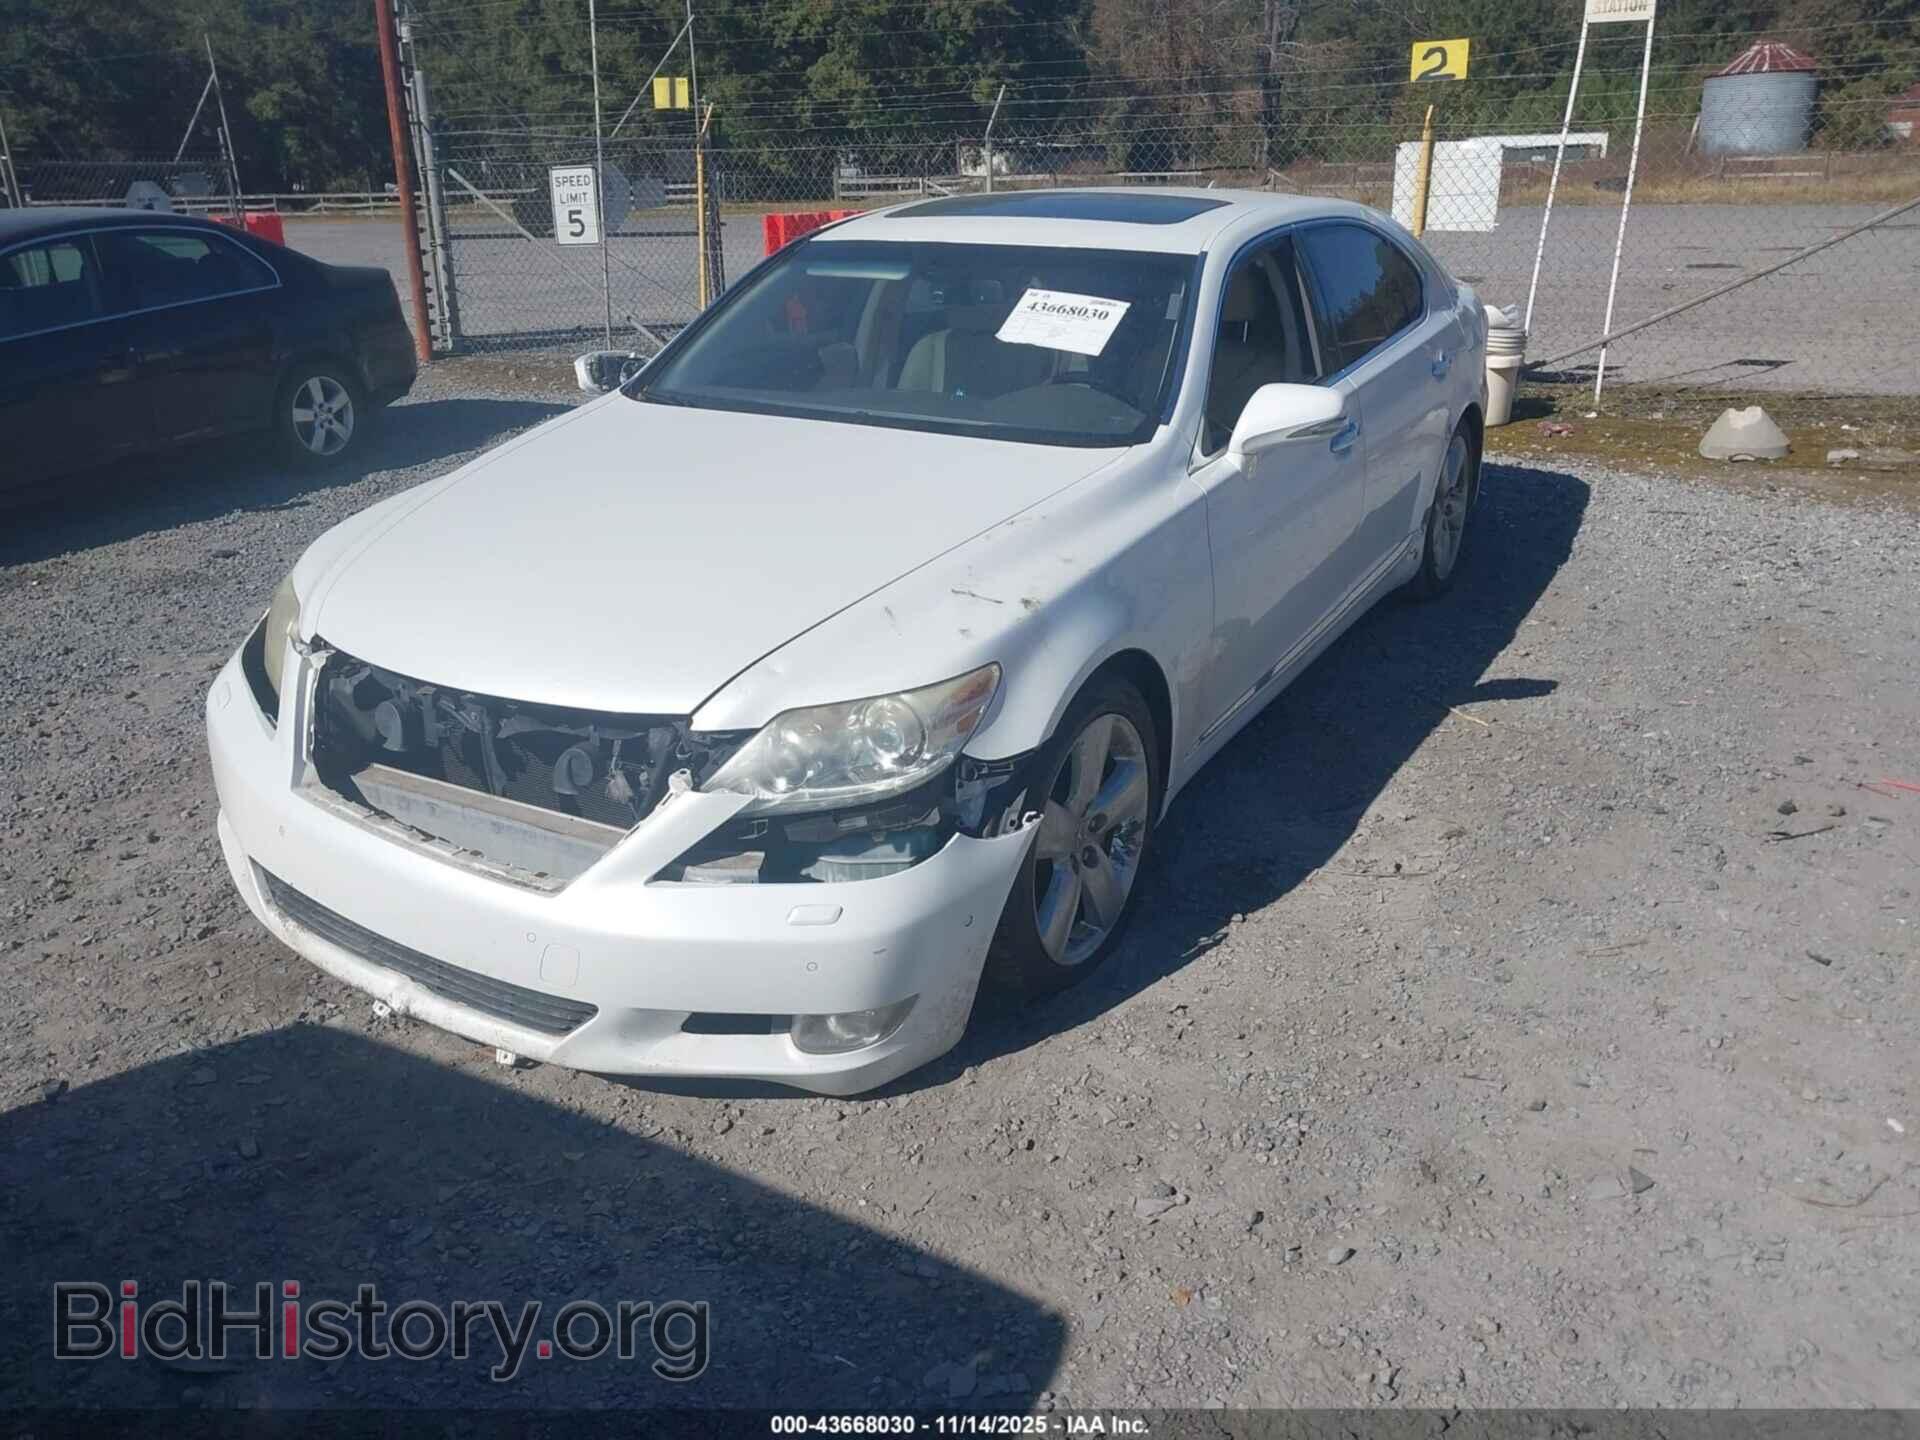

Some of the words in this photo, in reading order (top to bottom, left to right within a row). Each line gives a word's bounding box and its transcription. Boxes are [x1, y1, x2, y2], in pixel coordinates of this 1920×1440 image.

[1416, 46, 1456, 80] 2
[554, 174, 591, 187] SPEED
[559, 192, 588, 204] LIMIT
[568, 209, 585, 237] 5
[1027, 301, 1110, 320] 43668030
